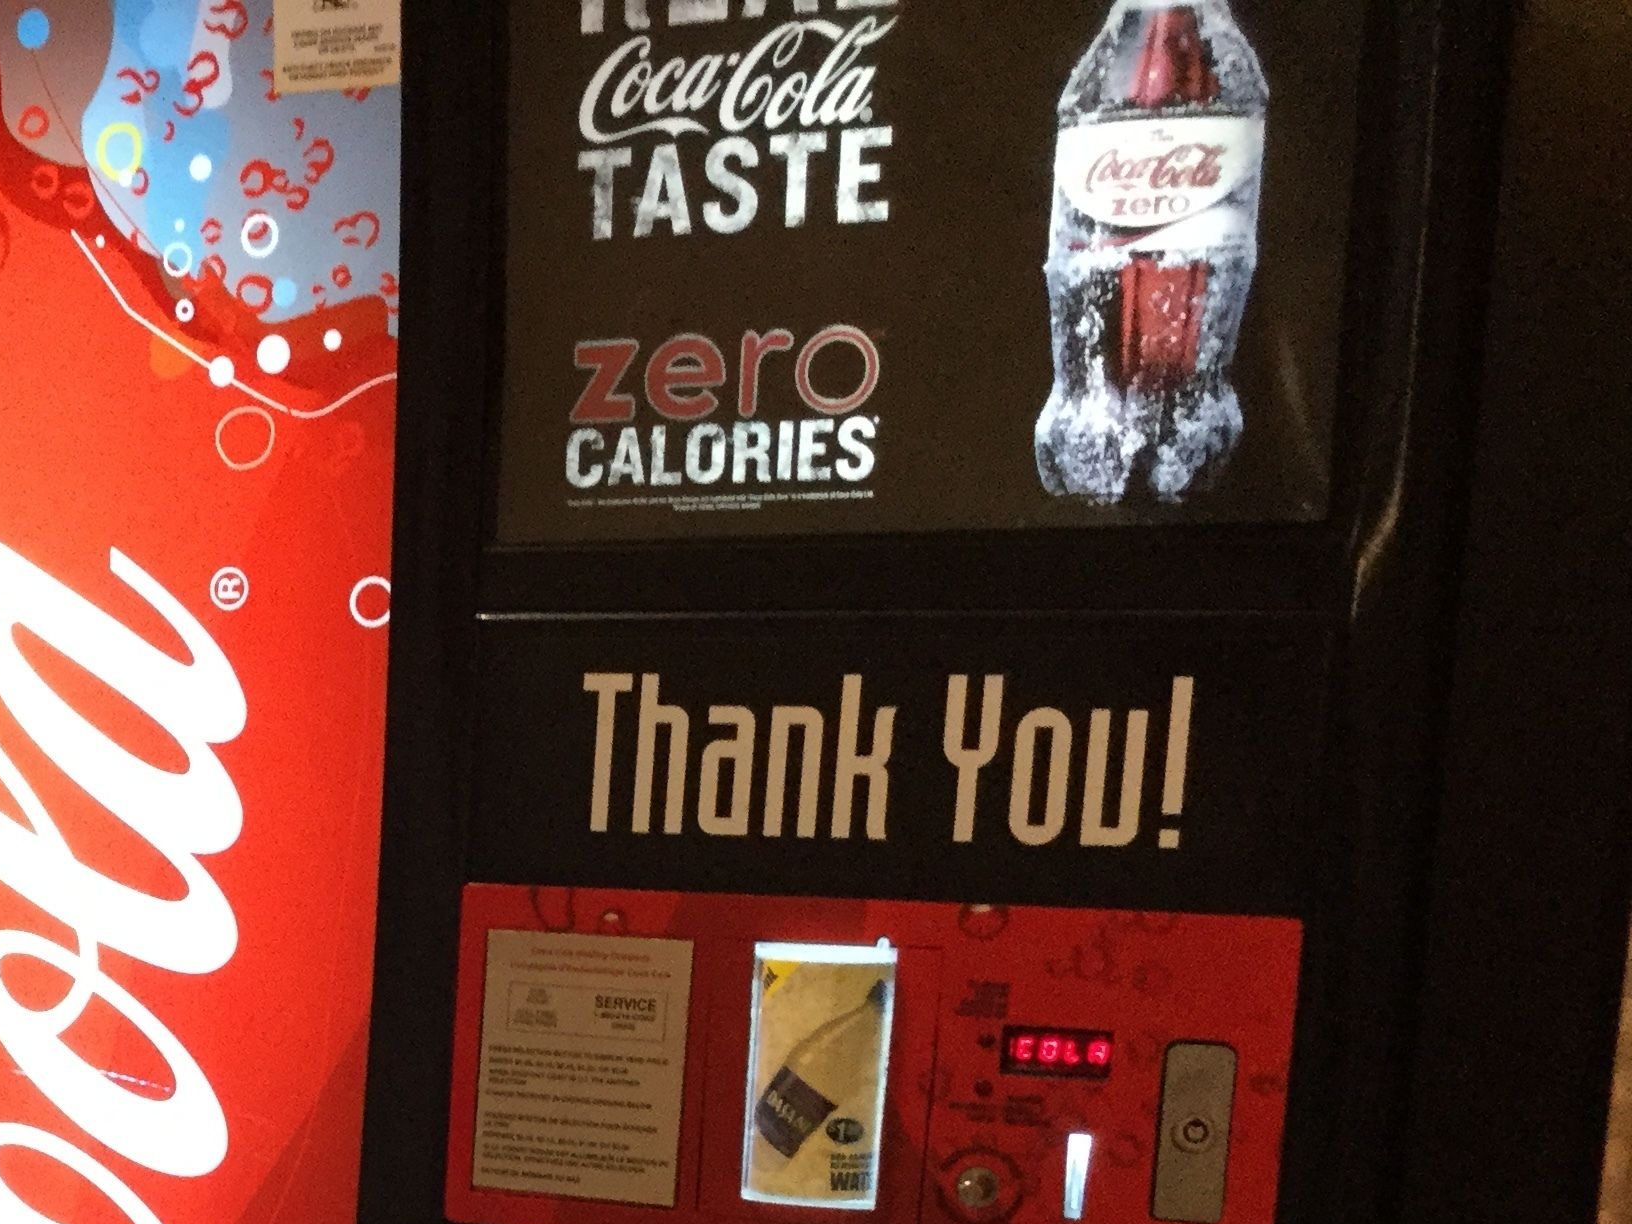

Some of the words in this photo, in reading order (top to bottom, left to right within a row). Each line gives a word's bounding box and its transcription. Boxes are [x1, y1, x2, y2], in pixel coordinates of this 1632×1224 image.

[579, 15, 899, 144] Coca-Cola
[578, 126, 893, 241] TASTE
[1111, 194, 1191, 217] zero
[569, 323, 881, 422] zero
[566, 415, 878, 489] CALORIES
[583, 672, 897, 841] Thank
[943, 673, 1195, 850] You!
[594, 993, 658, 1013] SERVICE
